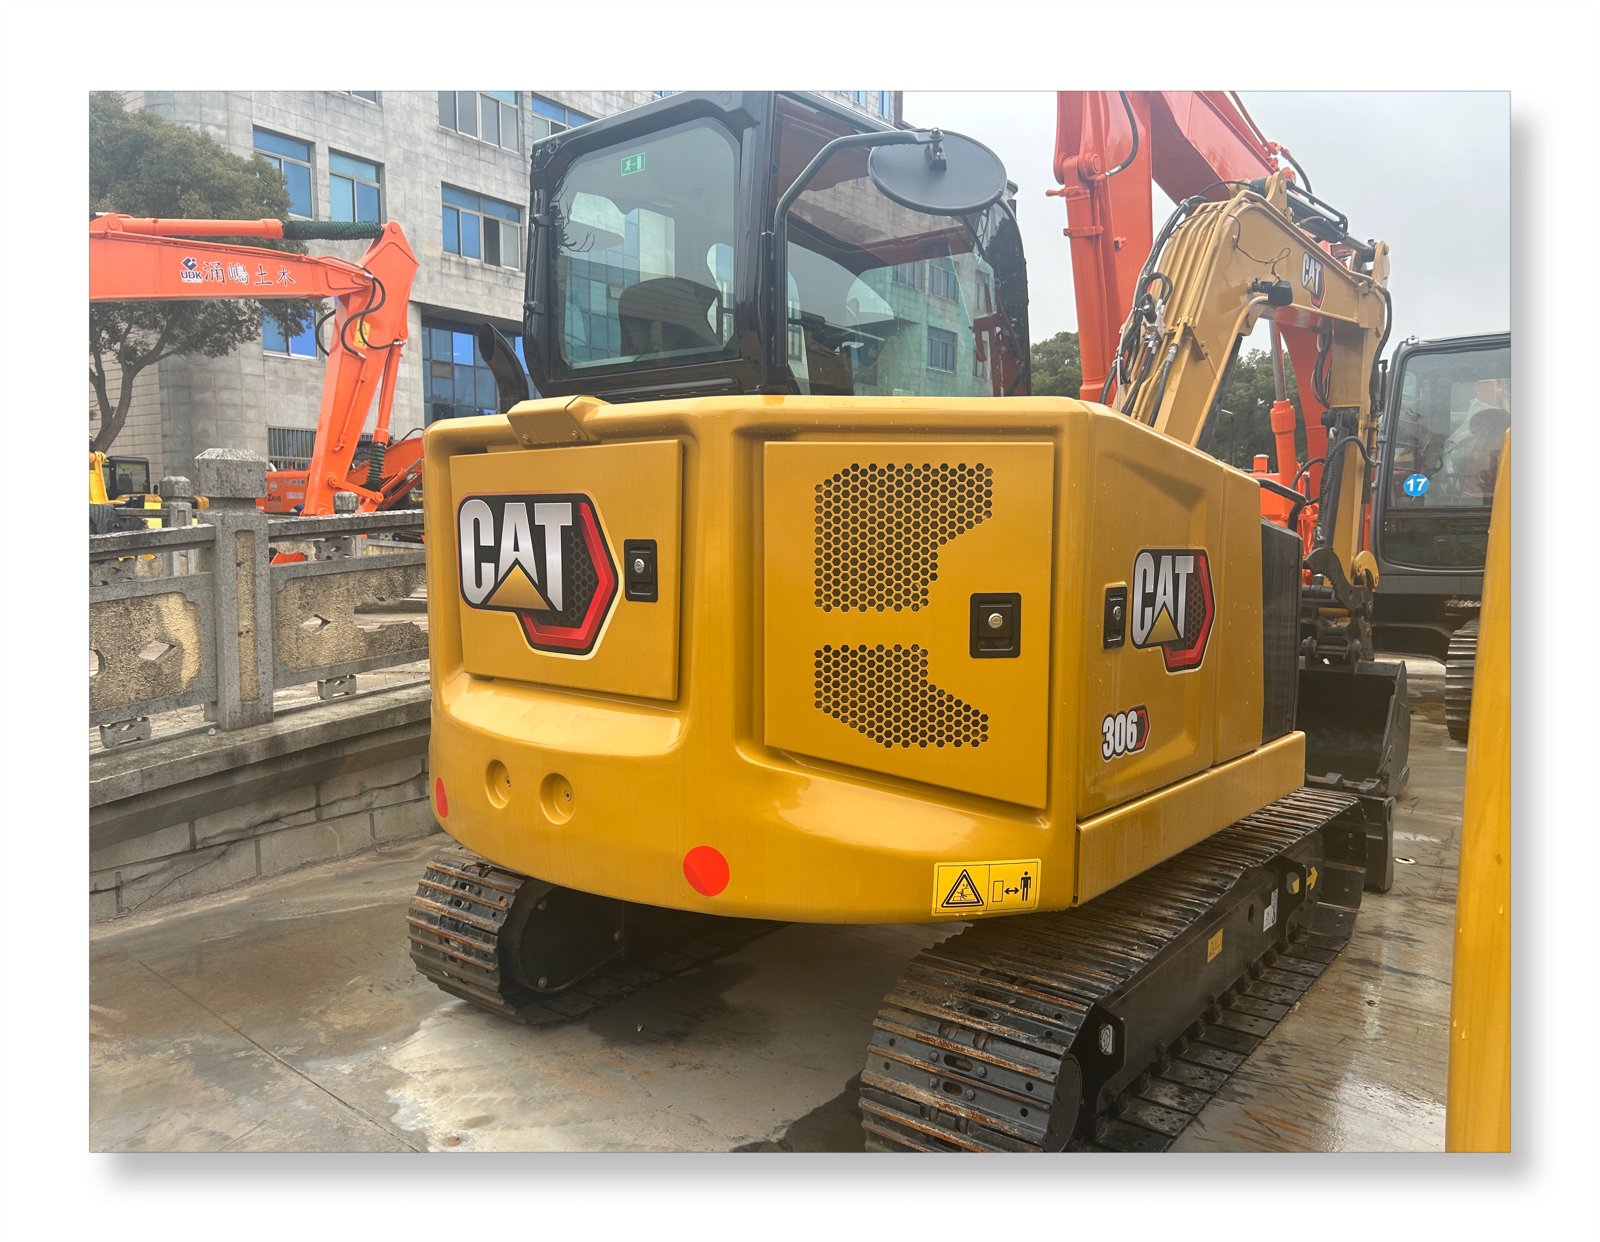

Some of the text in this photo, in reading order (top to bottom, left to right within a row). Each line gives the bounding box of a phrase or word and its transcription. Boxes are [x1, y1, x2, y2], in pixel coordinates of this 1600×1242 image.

[180, 270, 202, 280] UDK
[1302, 252, 1322, 295] CAT
[1406, 478, 1427, 491] 17
[459, 499, 573, 612] CAT
[1132, 552, 1194, 645] CAT
[1102, 710, 1138, 757] 306
